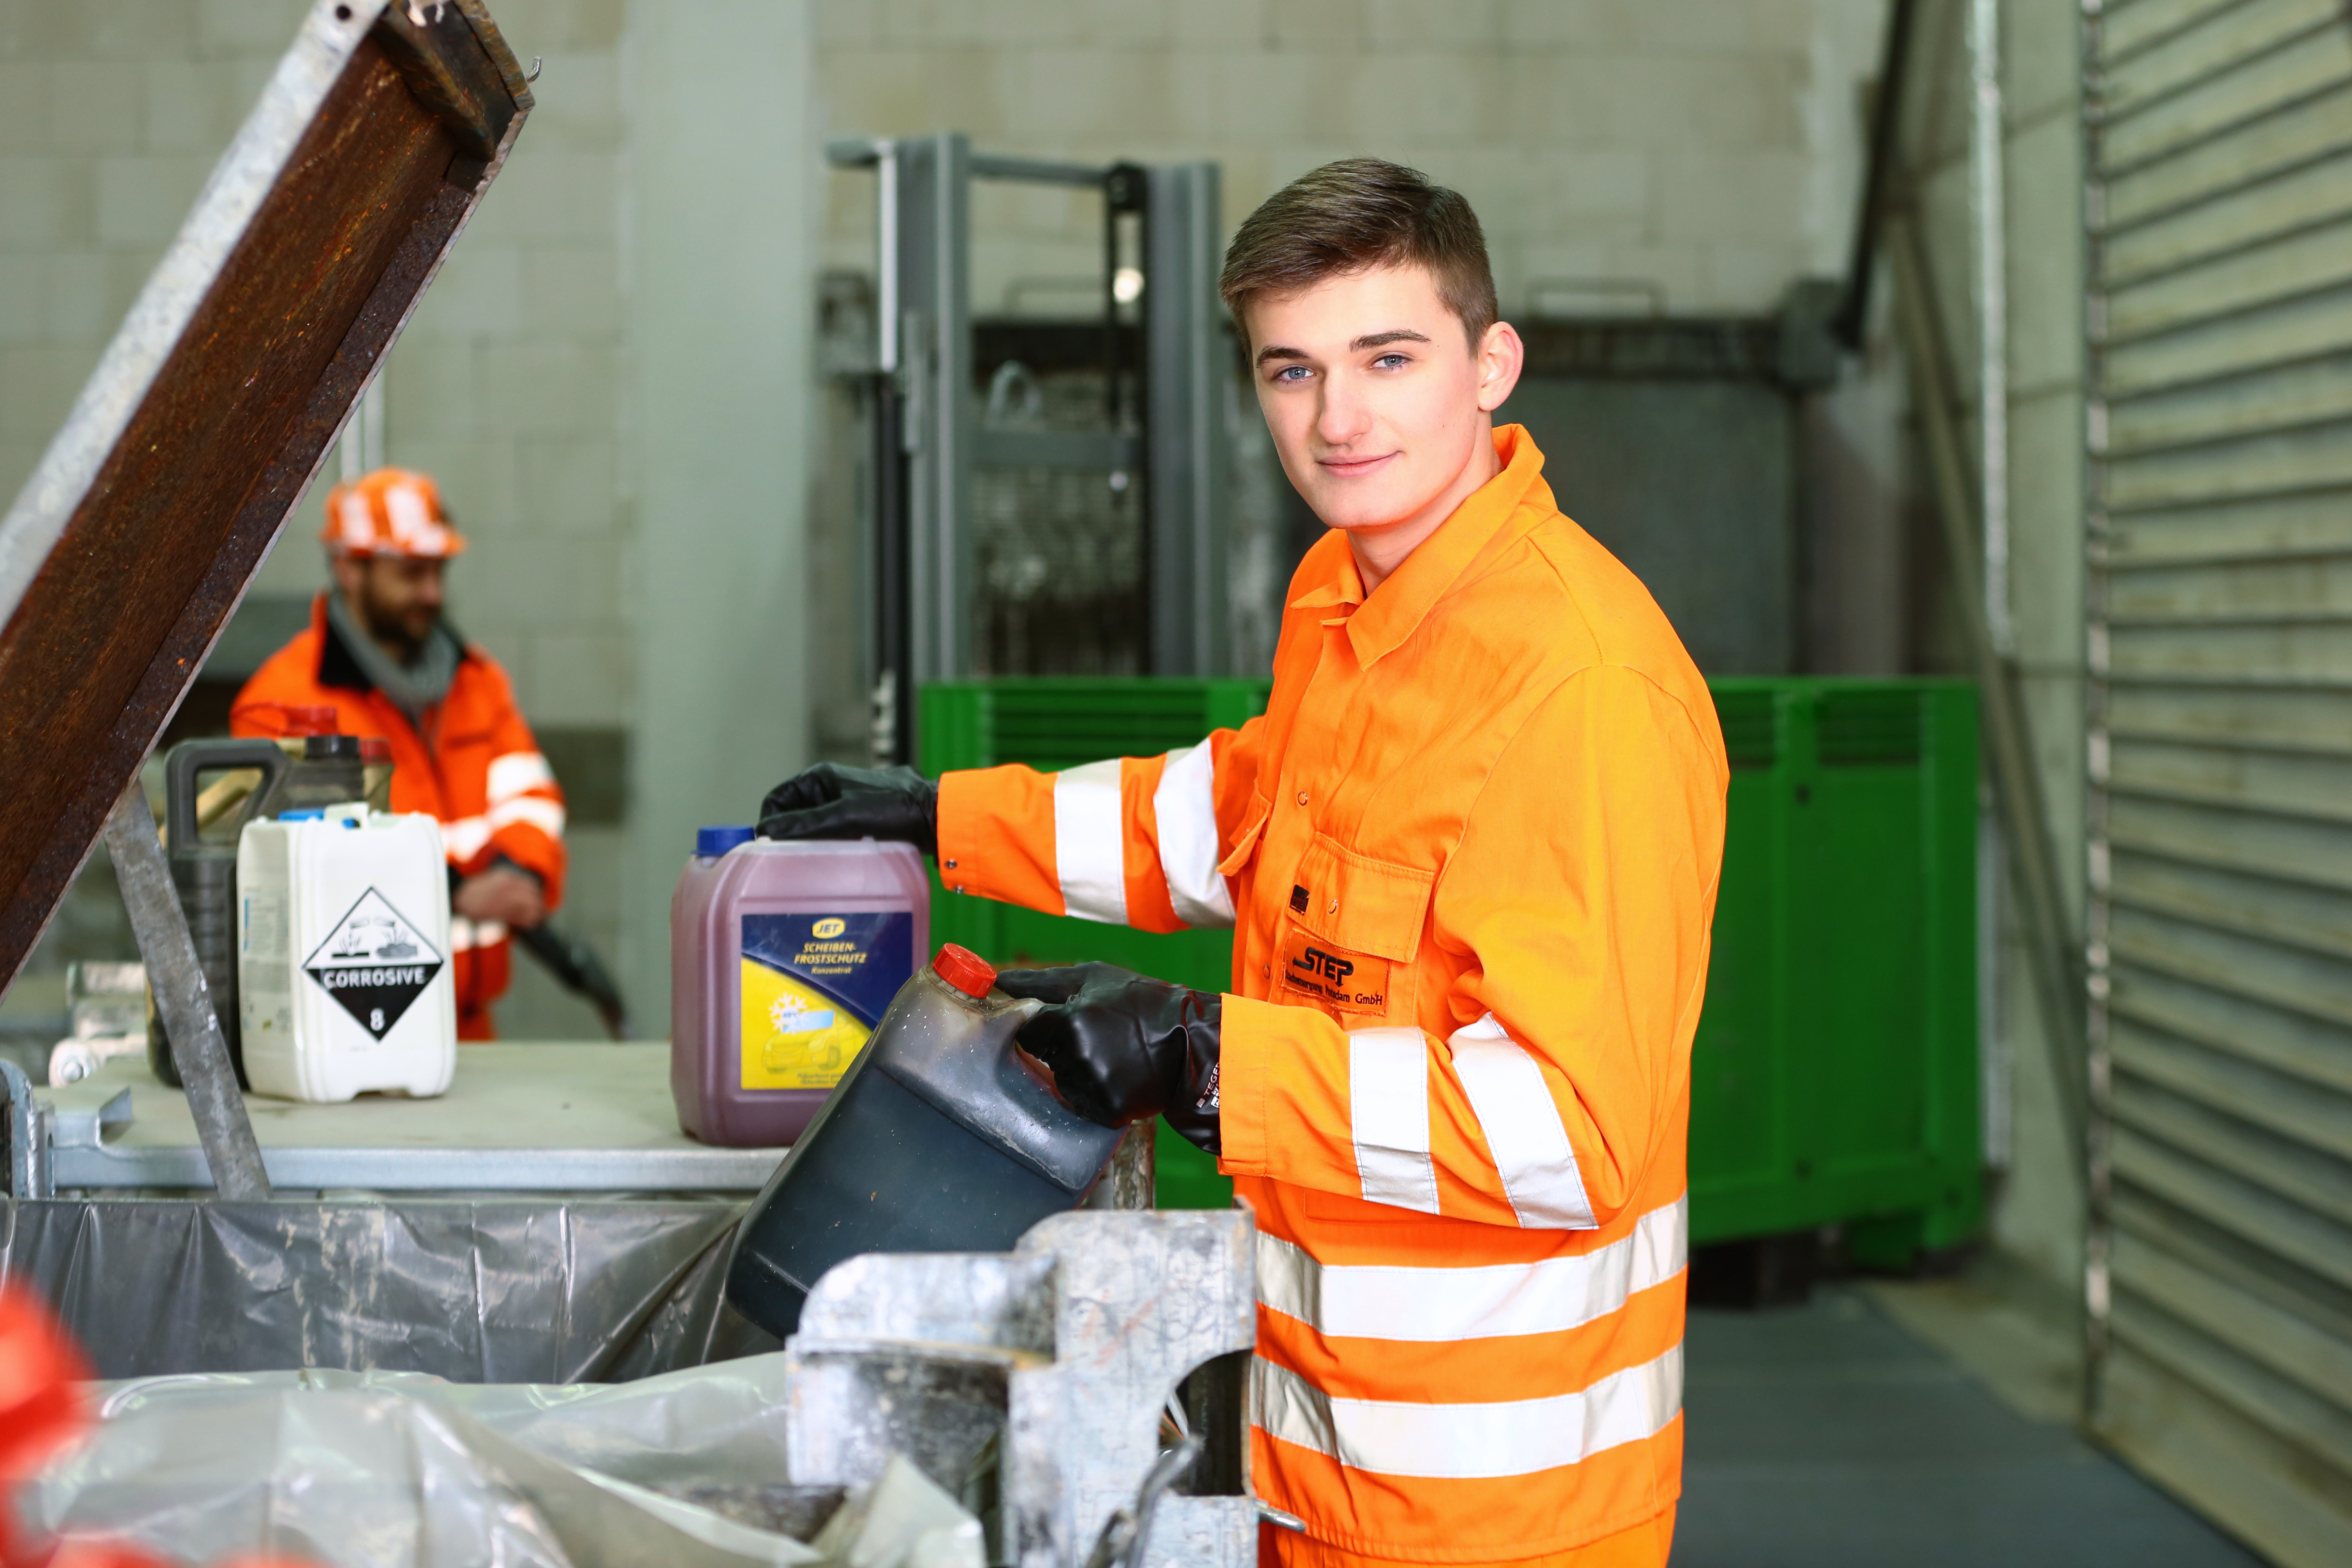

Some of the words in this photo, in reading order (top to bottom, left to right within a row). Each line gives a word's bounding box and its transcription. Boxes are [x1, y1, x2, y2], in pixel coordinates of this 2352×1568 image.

[817, 924, 840, 934] JET
[803, 942, 856, 953] SCHEIBEN-
[794, 953, 867, 964] FROSTSCHUTZ
[1293, 947, 1354, 987] STEP
[323, 967, 425, 988] CORROSIVE
[1355, 993, 1383, 1005] GmbH
[370, 1008, 385, 1031] 8
